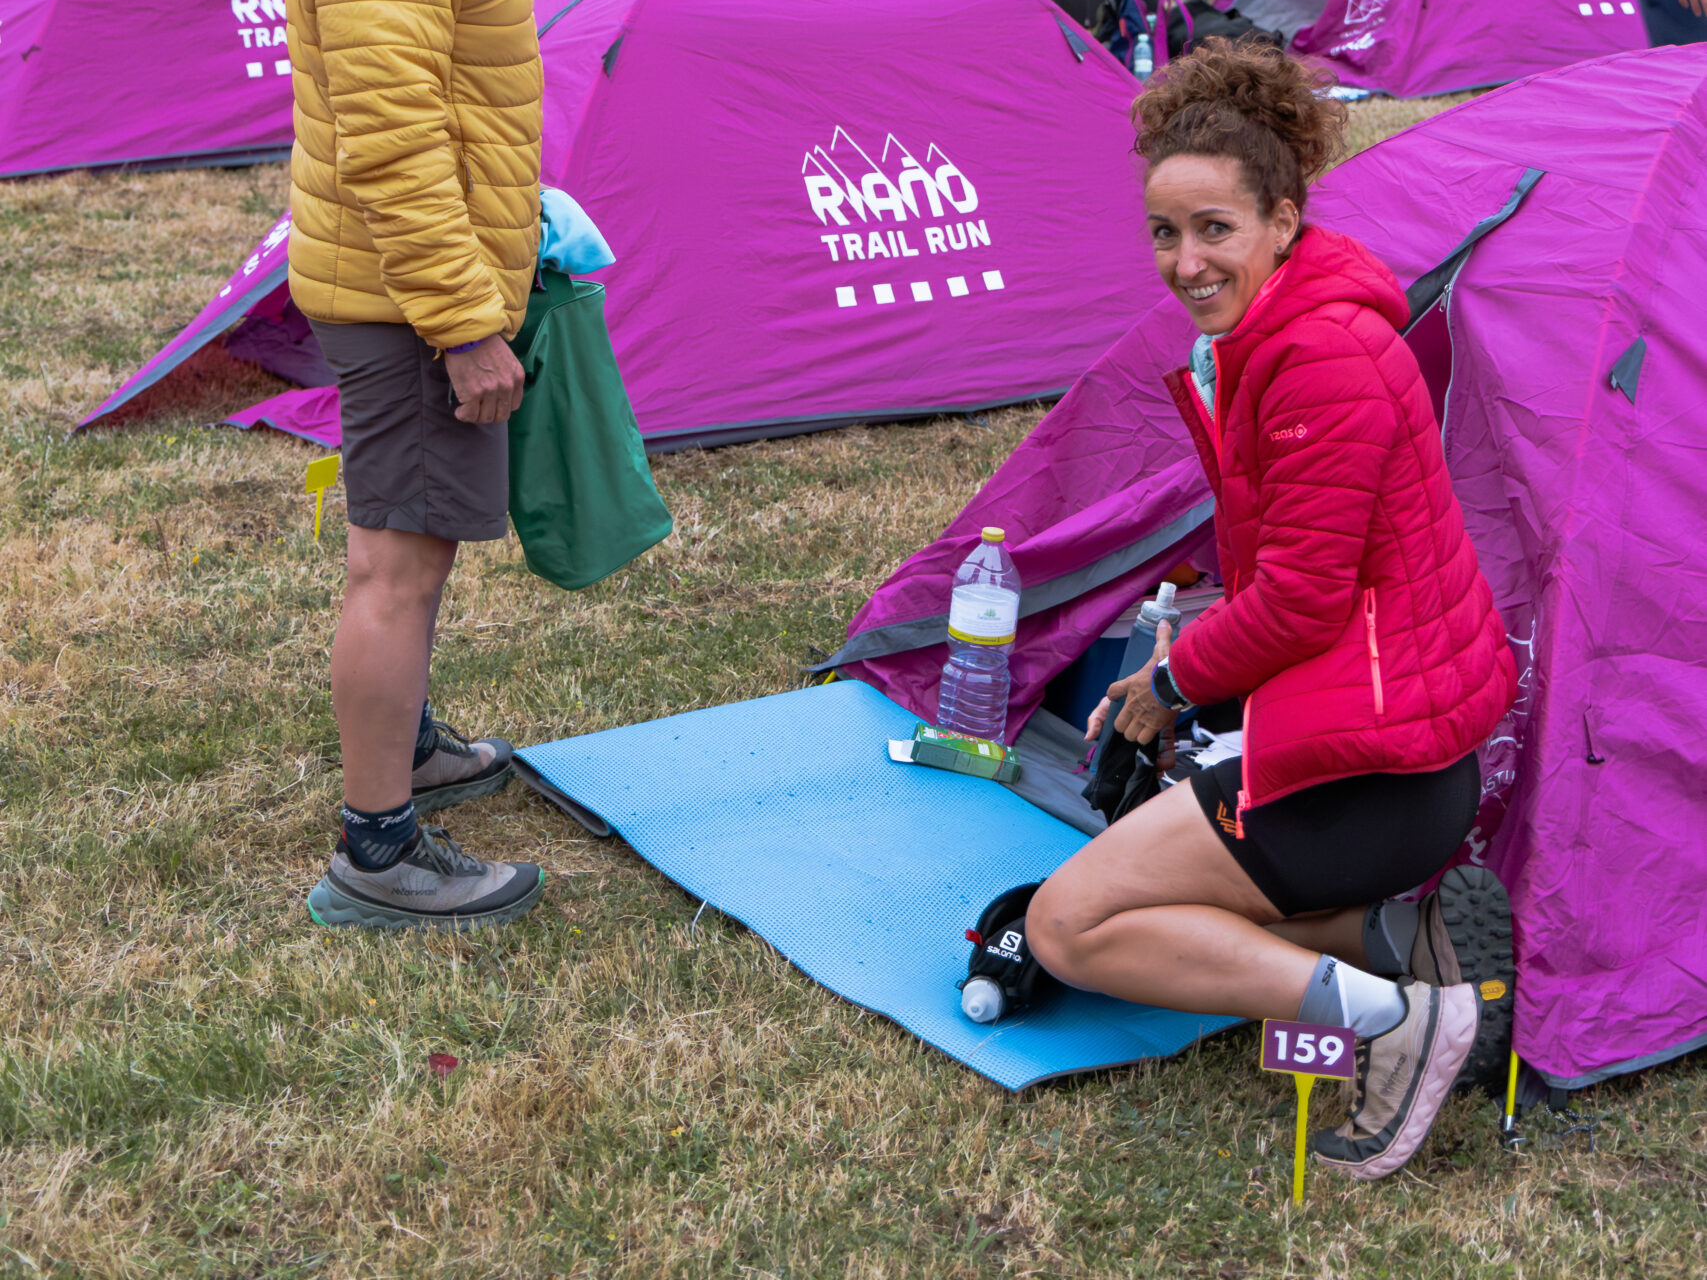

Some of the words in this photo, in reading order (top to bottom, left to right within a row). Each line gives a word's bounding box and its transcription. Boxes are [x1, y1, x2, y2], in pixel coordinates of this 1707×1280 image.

[820, 230, 920, 262] TRAIL
[924, 219, 992, 254] RUN
[1274, 1030, 1345, 1066] 159
